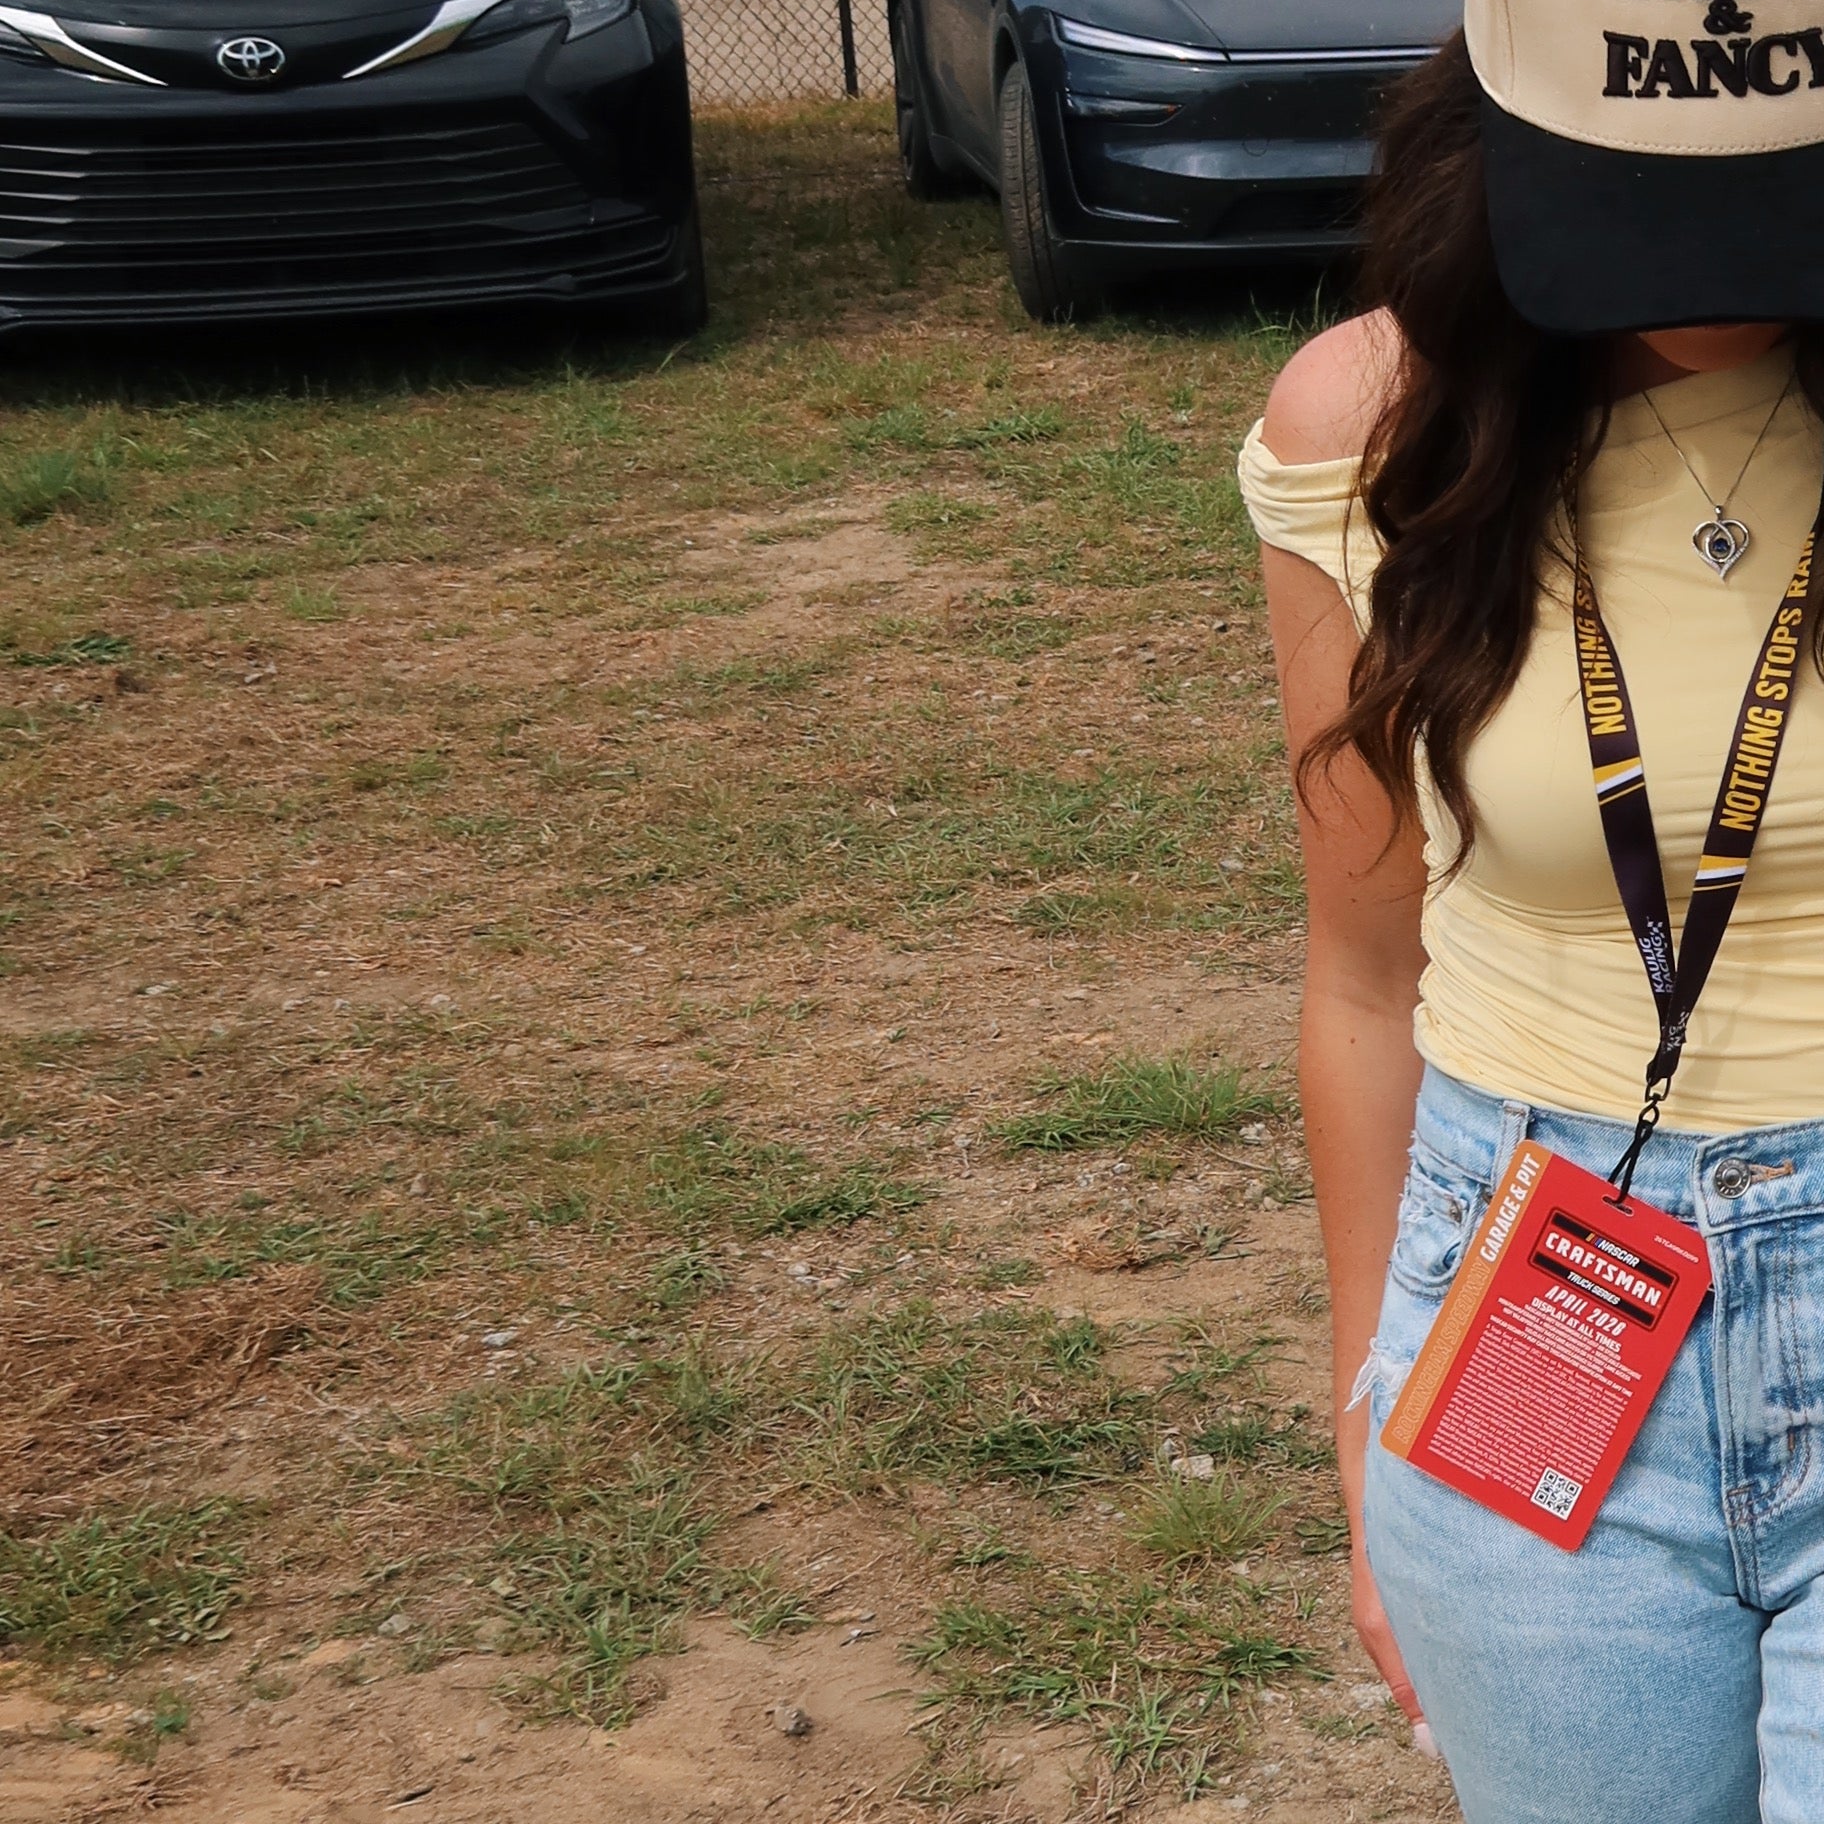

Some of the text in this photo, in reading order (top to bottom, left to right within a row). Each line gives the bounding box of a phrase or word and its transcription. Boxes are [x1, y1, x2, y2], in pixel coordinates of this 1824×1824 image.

[1576, 616, 1628, 736] NOTHING
[1719, 705, 1785, 832] NOTHING
[1755, 607, 1803, 702] STOPS
[1639, 937, 1665, 993] KAULIG
[1650, 936, 1674, 993] RACING
[1509, 1183, 1529, 1201] &
[1515, 1152, 1541, 1187] PIT
[1480, 1196, 1521, 1263] GARAGE
[1597, 1239, 1640, 1268] NASCAR
[1545, 1232, 1662, 1307] CRAFTSMAN
[1567, 1271, 1621, 1305] TRUCK SERIES
[1440, 1256, 1491, 1348] SPEEDWAY
[1531, 1297, 1621, 1353] DISPLAY AT ALL TIMES
[1544, 1285, 1588, 1315] APRIL
[1391, 1337, 1453, 1445] ROCKINGHAM
